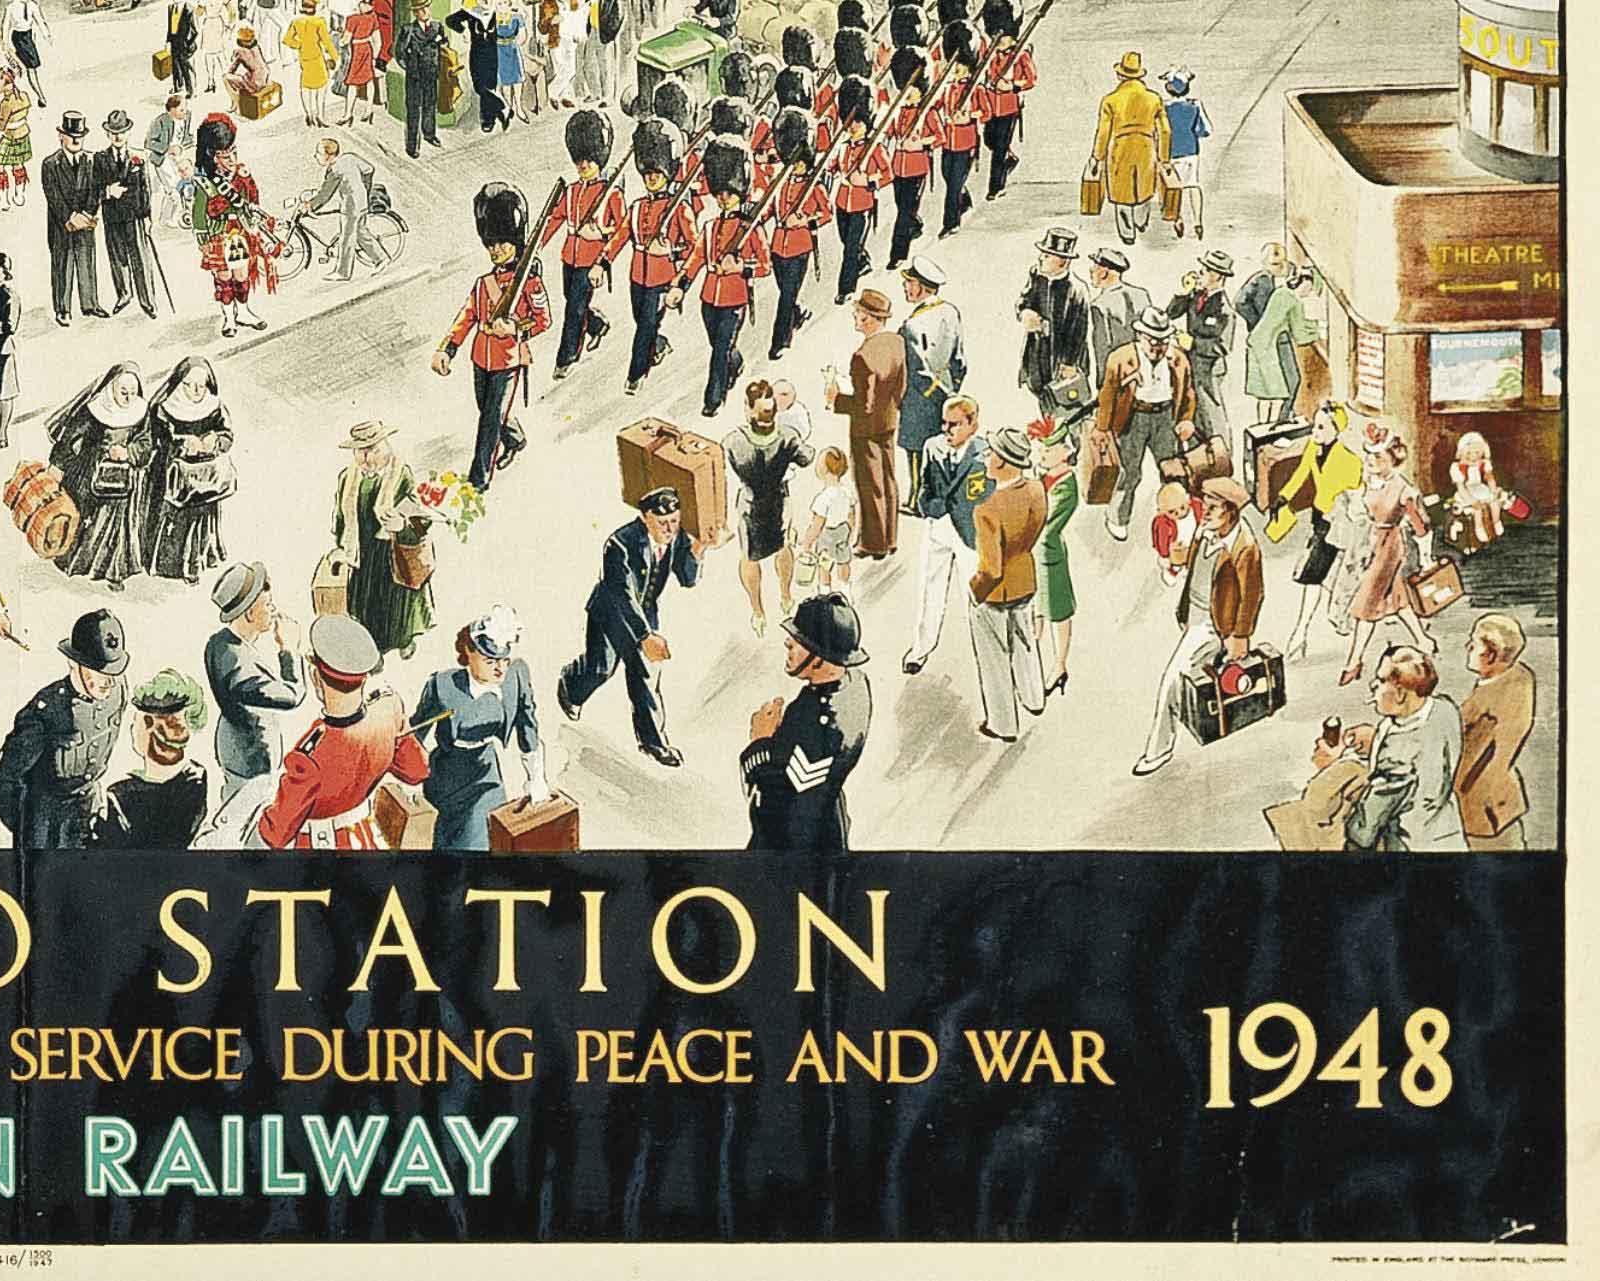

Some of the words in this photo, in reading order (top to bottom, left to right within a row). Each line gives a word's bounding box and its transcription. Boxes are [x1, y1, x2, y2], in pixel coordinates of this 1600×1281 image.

[1460, 16, 1558, 70] SOUT
[1440, 245, 1543, 264] THEATRE
[157, 885, 890, 994] STATION
[10, 1026, 243, 1083] SERVICE
[281, 1027, 534, 1086] DURING
[575, 1028, 753, 1083] PEACE
[786, 1028, 938, 1084] AND
[964, 1029, 1116, 1085] WAR
[1202, 1002, 1453, 1108] 1948
[85, 1114, 519, 1197] RAILWAY
